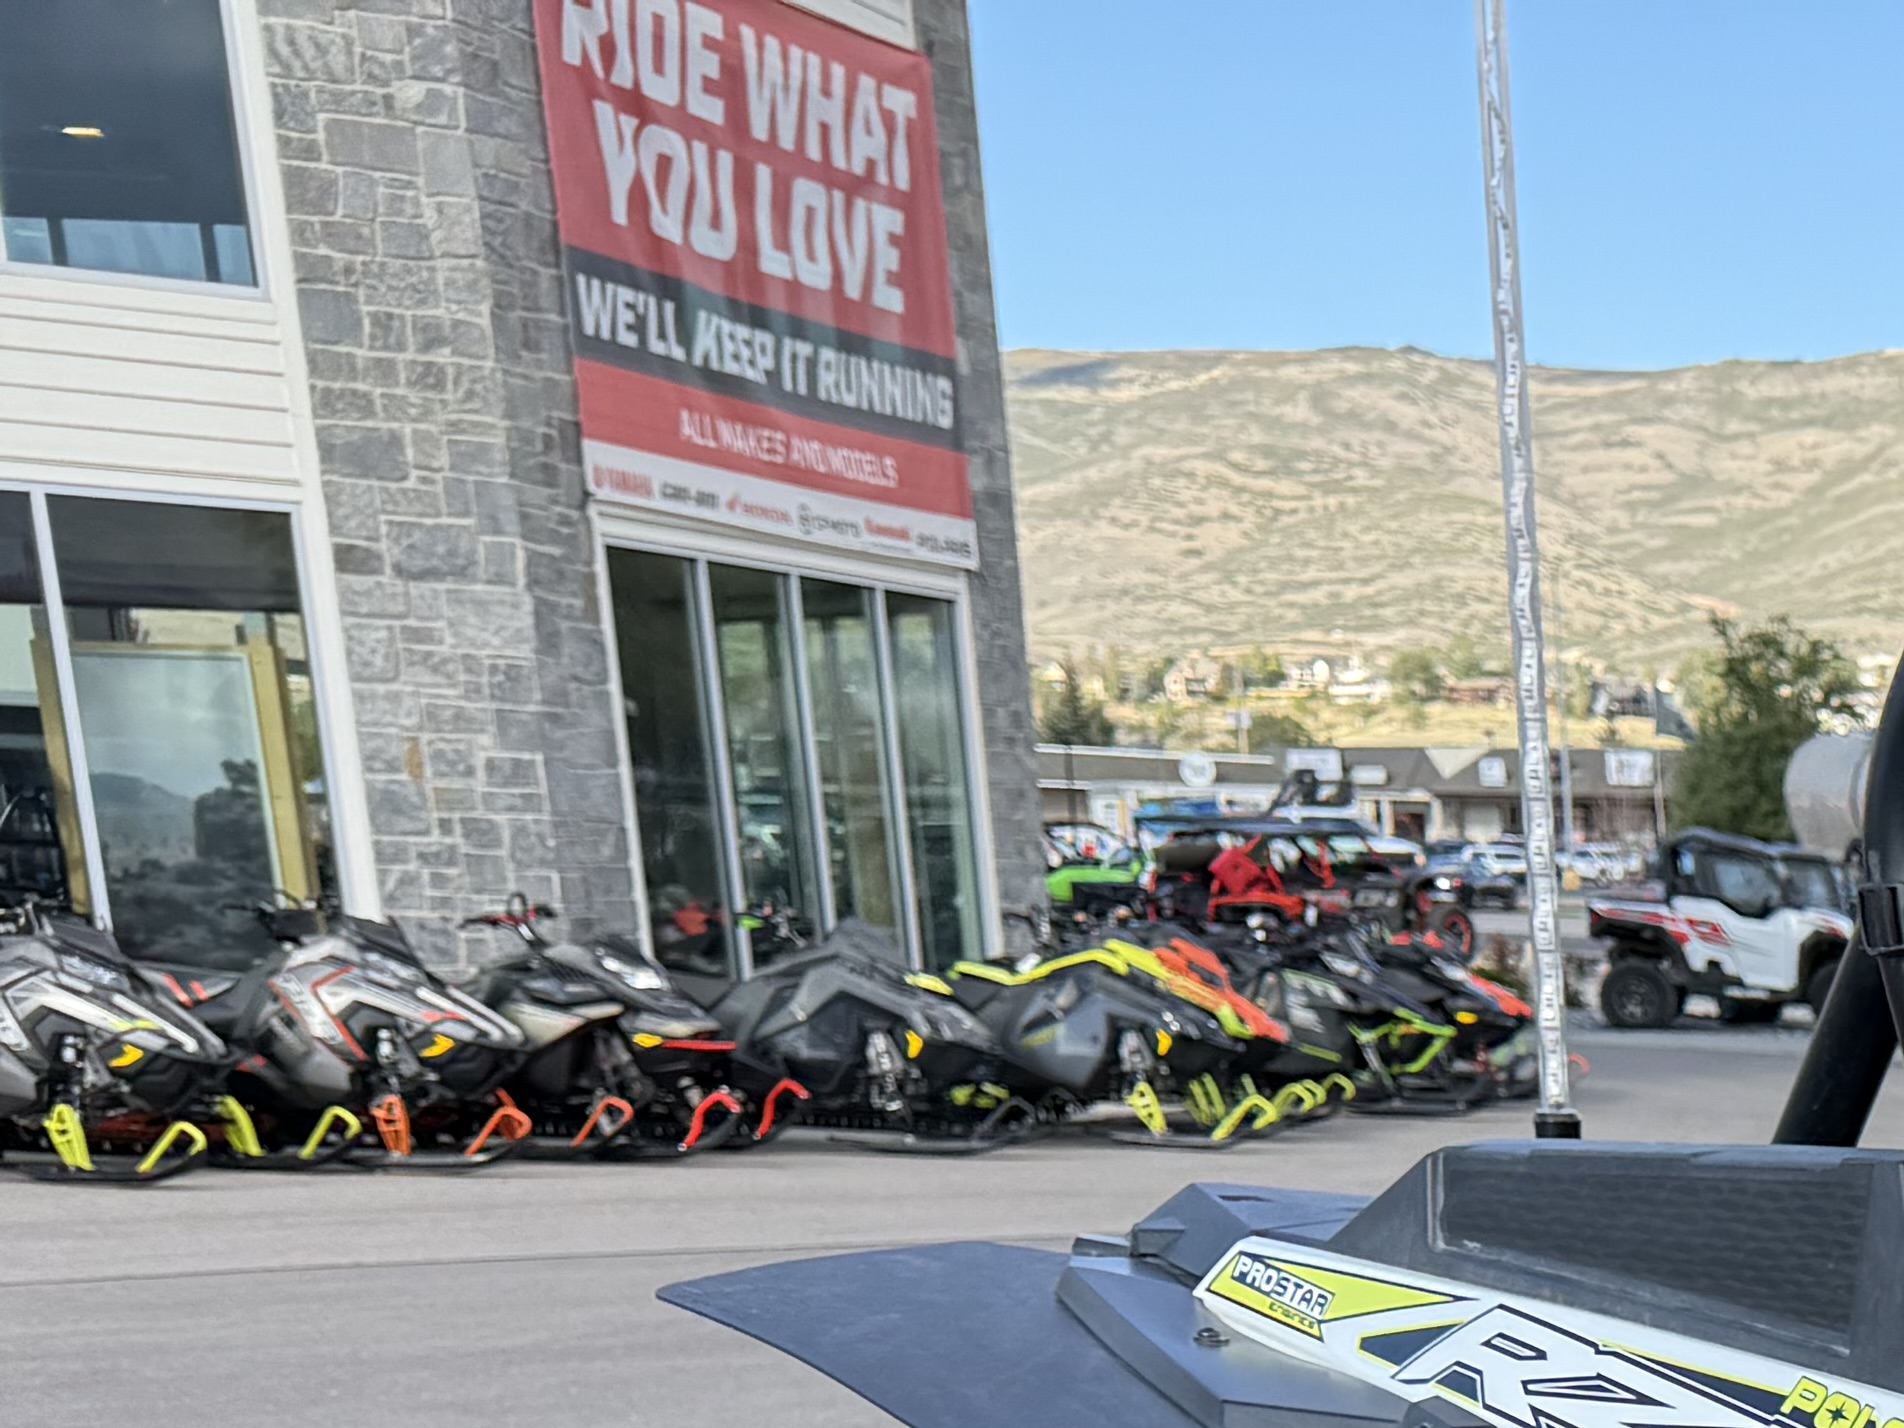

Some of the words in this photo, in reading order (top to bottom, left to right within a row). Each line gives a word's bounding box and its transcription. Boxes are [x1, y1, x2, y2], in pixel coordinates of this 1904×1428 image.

[562, 0, 725, 126] RIDE
[738, 23, 918, 193] WHAT
[593, 99, 738, 263] YOU
[754, 162, 906, 315] LOVE
[575, 272, 687, 363] WE'LL
[691, 310, 777, 386] KEEP
[780, 335, 816, 398] IT
[816, 345, 955, 431] RUNNING
[679, 408, 716, 449] ALL
[716, 416, 788, 465] MAKES
[788, 434, 826, 472] AND
[826, 445, 900, 489] MODELS
[1232, 1254, 1333, 1318] PROSTAR
